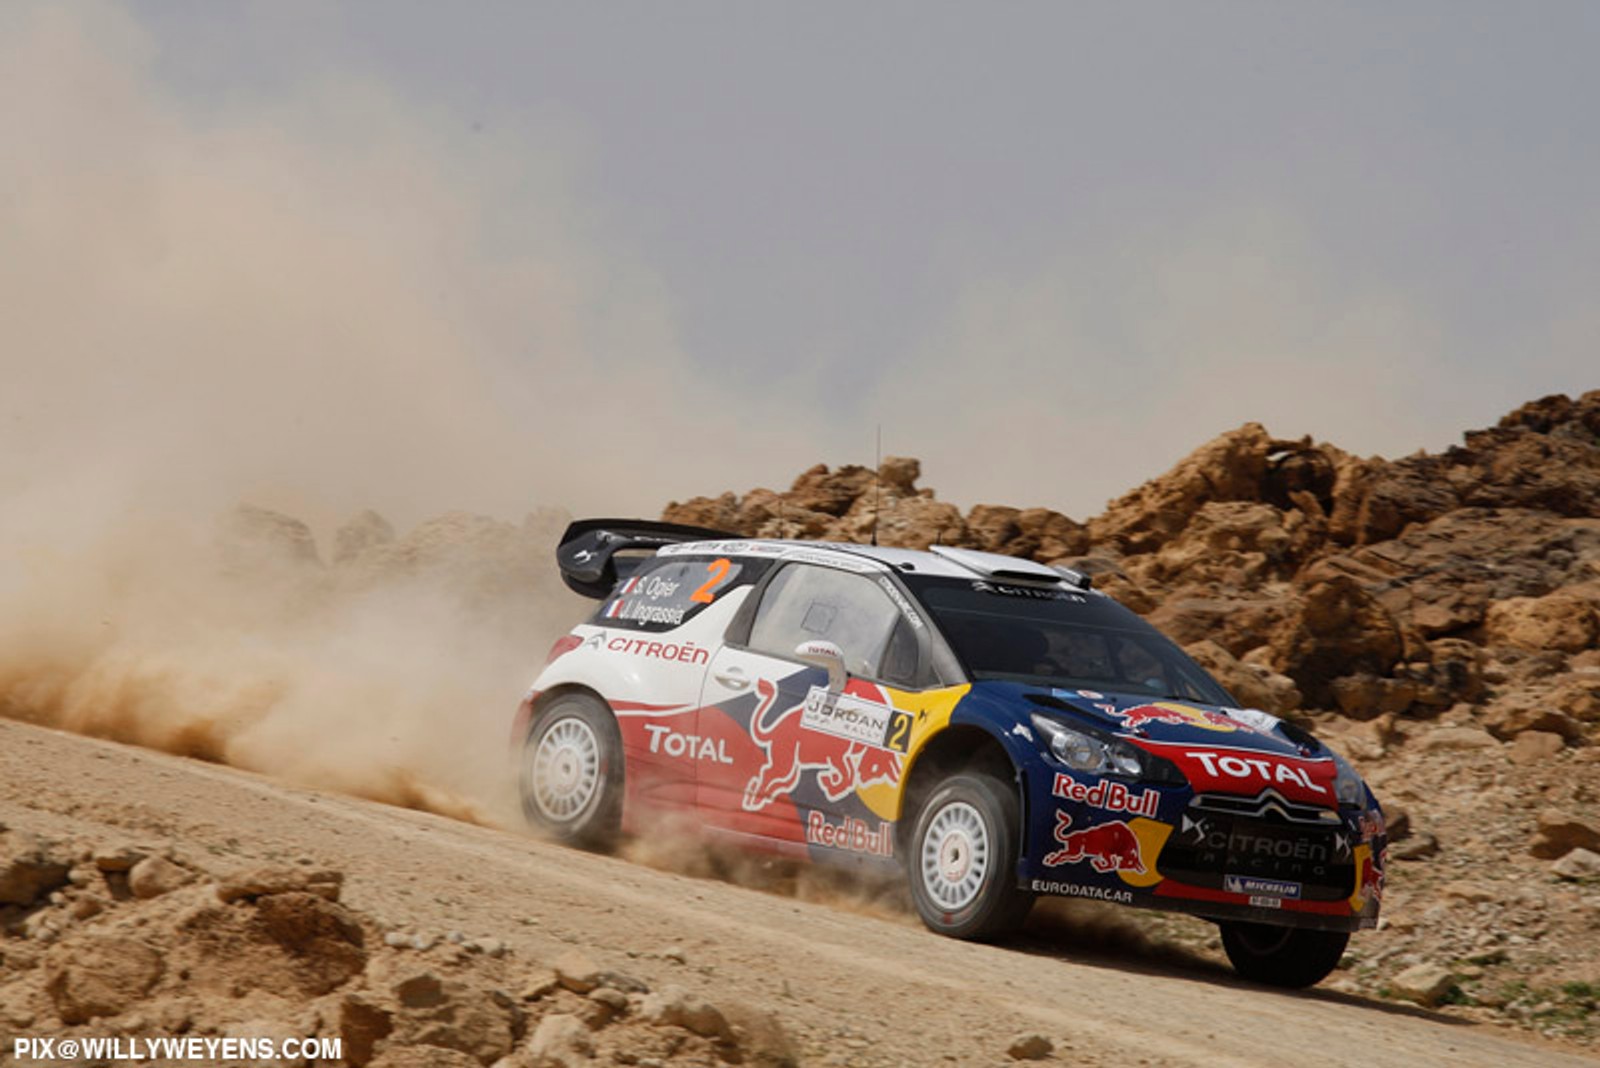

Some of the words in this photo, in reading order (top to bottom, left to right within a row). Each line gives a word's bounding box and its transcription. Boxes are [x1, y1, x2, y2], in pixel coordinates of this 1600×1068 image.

[646, 576, 680, 600] Ogier
[689, 557, 732, 604] 2
[631, 599, 686, 626] Ingrassia
[807, 646, 838, 657] TOTAL
[807, 701, 885, 730] JORDAN
[887, 713, 909, 752] 2
[643, 723, 734, 765] TOTAL
[1185, 752, 1328, 794] TOTAL
[1052, 771, 1109, 809] Red
[1105, 782, 1161, 819] Bull
[807, 809, 851, 850] Red
[851, 817, 894, 858] Bull
[1031, 879, 1133, 903] EURODATACAR
[1244, 881, 1298, 895] MICHELIN
